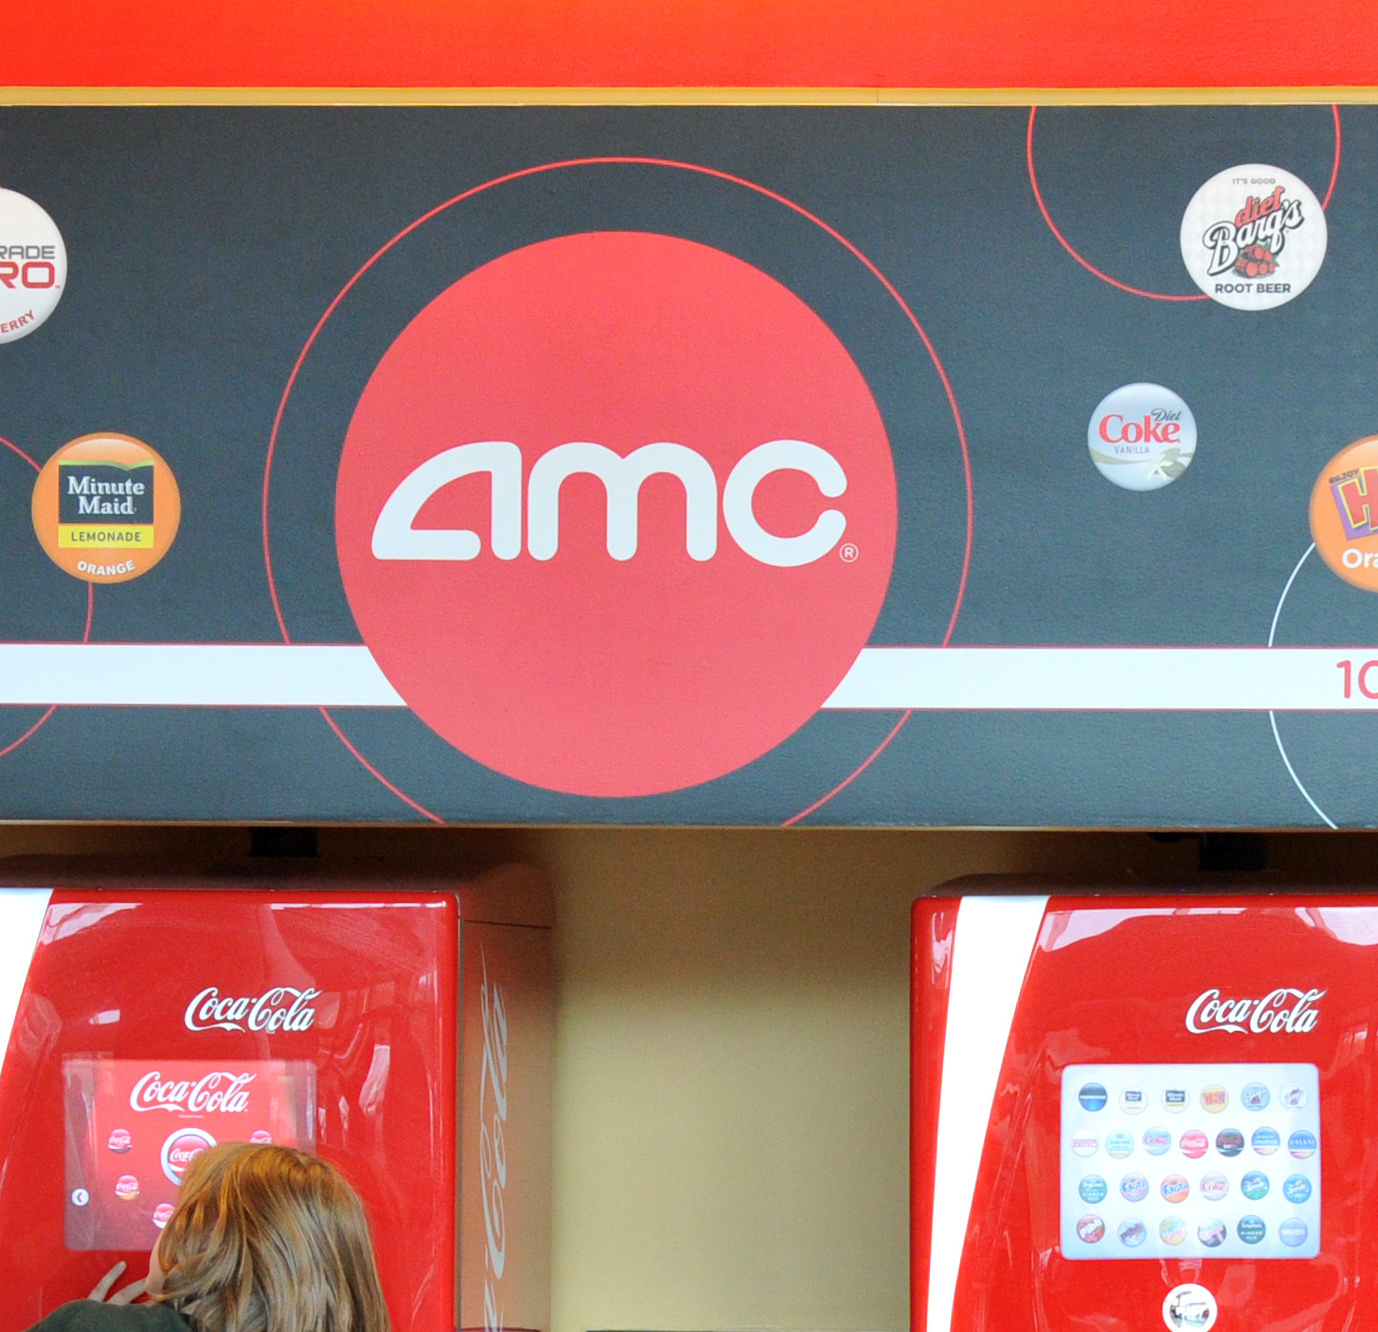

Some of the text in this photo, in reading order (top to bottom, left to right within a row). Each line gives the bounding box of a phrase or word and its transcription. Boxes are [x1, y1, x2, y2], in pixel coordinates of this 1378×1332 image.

[1234, 185, 1285, 228] diet
[1202, 199, 1305, 277] Barq's
[1215, 284, 1291, 293] ROOT BEER
[1151, 408, 1182, 421] Diet
[1099, 414, 1180, 443] Coke
[1114, 446, 1150, 454] VANILLA
[67, 477, 145, 497] Minute
[78, 495, 134, 516] Maid
[70, 530, 142, 543] LEMONADE
[76, 560, 136, 578] ORANGE
[184, 987, 324, 1033] Coca-Cola
[1185, 988, 1328, 1034] Coca-Cola
[130, 1070, 257, 1113] Coca-Cola
